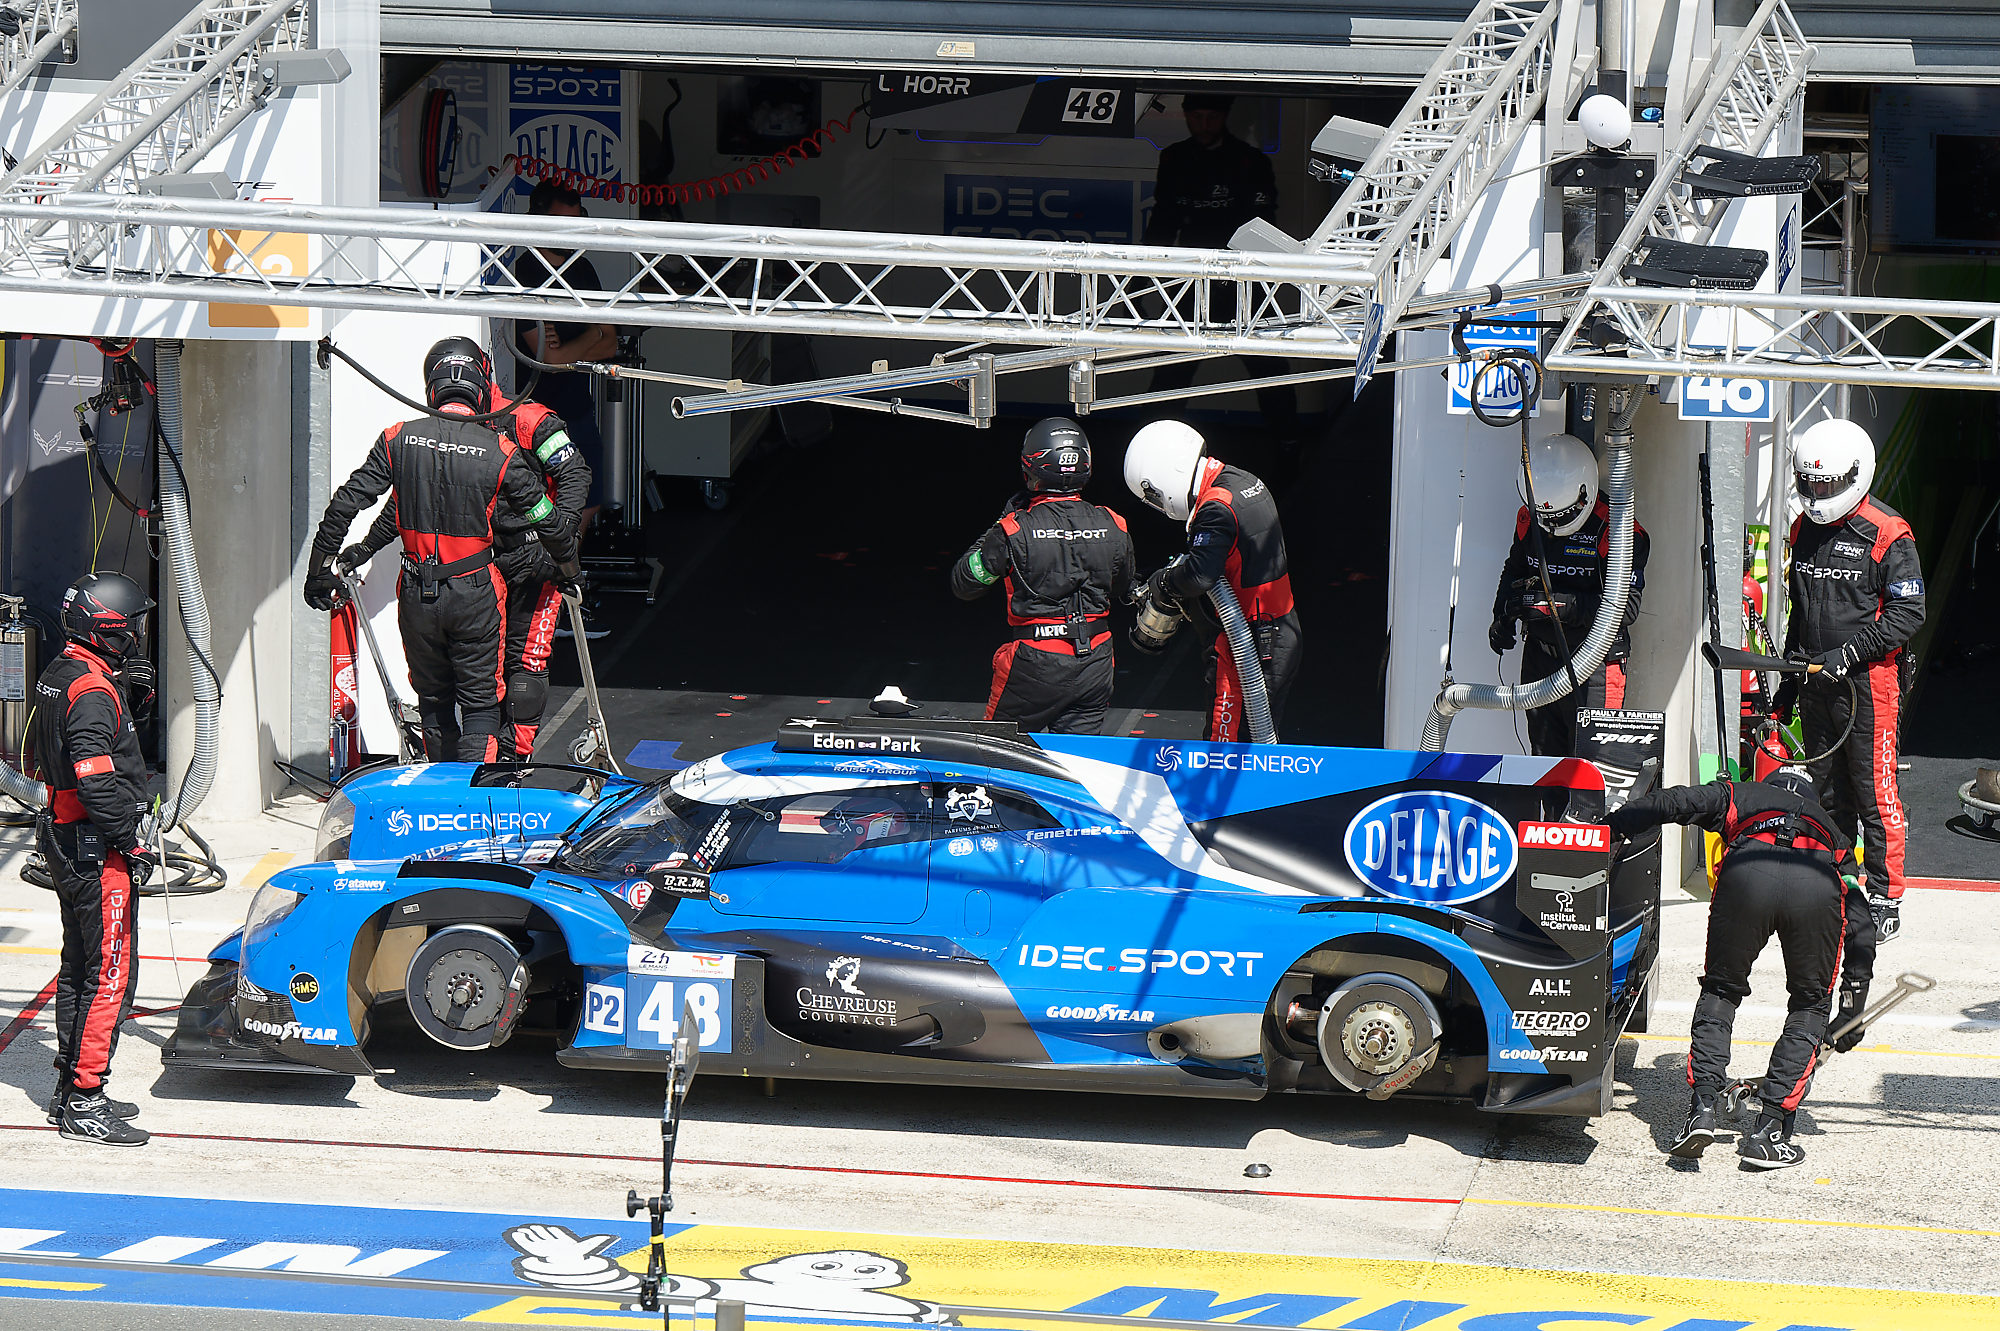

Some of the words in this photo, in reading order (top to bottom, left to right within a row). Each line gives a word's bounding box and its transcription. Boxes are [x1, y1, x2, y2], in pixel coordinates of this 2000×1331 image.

[513, 76, 620, 97] SPORT
[903, 75, 971, 95] HORR
[1067, 91, 1116, 121] 48
[1060, 454, 1079, 464] SEB
[1590, 709, 1617, 717] PAULY
[1626, 711, 1664, 719] PARTNER
[1594, 722, 1660, 730] www.paulyundpartner.de
[813, 733, 855, 749] Eden
[880, 736, 922, 752] Park
[1590, 732, 1658, 745] spark
[833, 766, 874, 774] RAISCH
[877, 768, 917, 776] GROUP
[1025, 825, 1135, 841] fenetre24.com
[1523, 826, 1605, 848] MOTUL
[1363, 808, 1501, 888] DELAGE
[348, 878, 386, 890] atawey
[1540, 912, 1576, 923] Institut
[1549, 921, 1591, 931] Cerveau
[290, 981, 318, 994] HMS
[588, 991, 620, 1027] P2
[796, 987, 897, 1014] CHEVREUSE
[637, 981, 721, 1047] 48
[799, 1010, 898, 1026] COURTAGE
[1046, 1004, 1155, 1022] GOODYEAR
[1511, 1010, 1591, 1031] TECPRO
[244, 1018, 338, 1041] GOODYEAR
[1499, 1047, 1589, 1063] GOODYEAR
[1384, 1064, 1418, 1089] brembo
